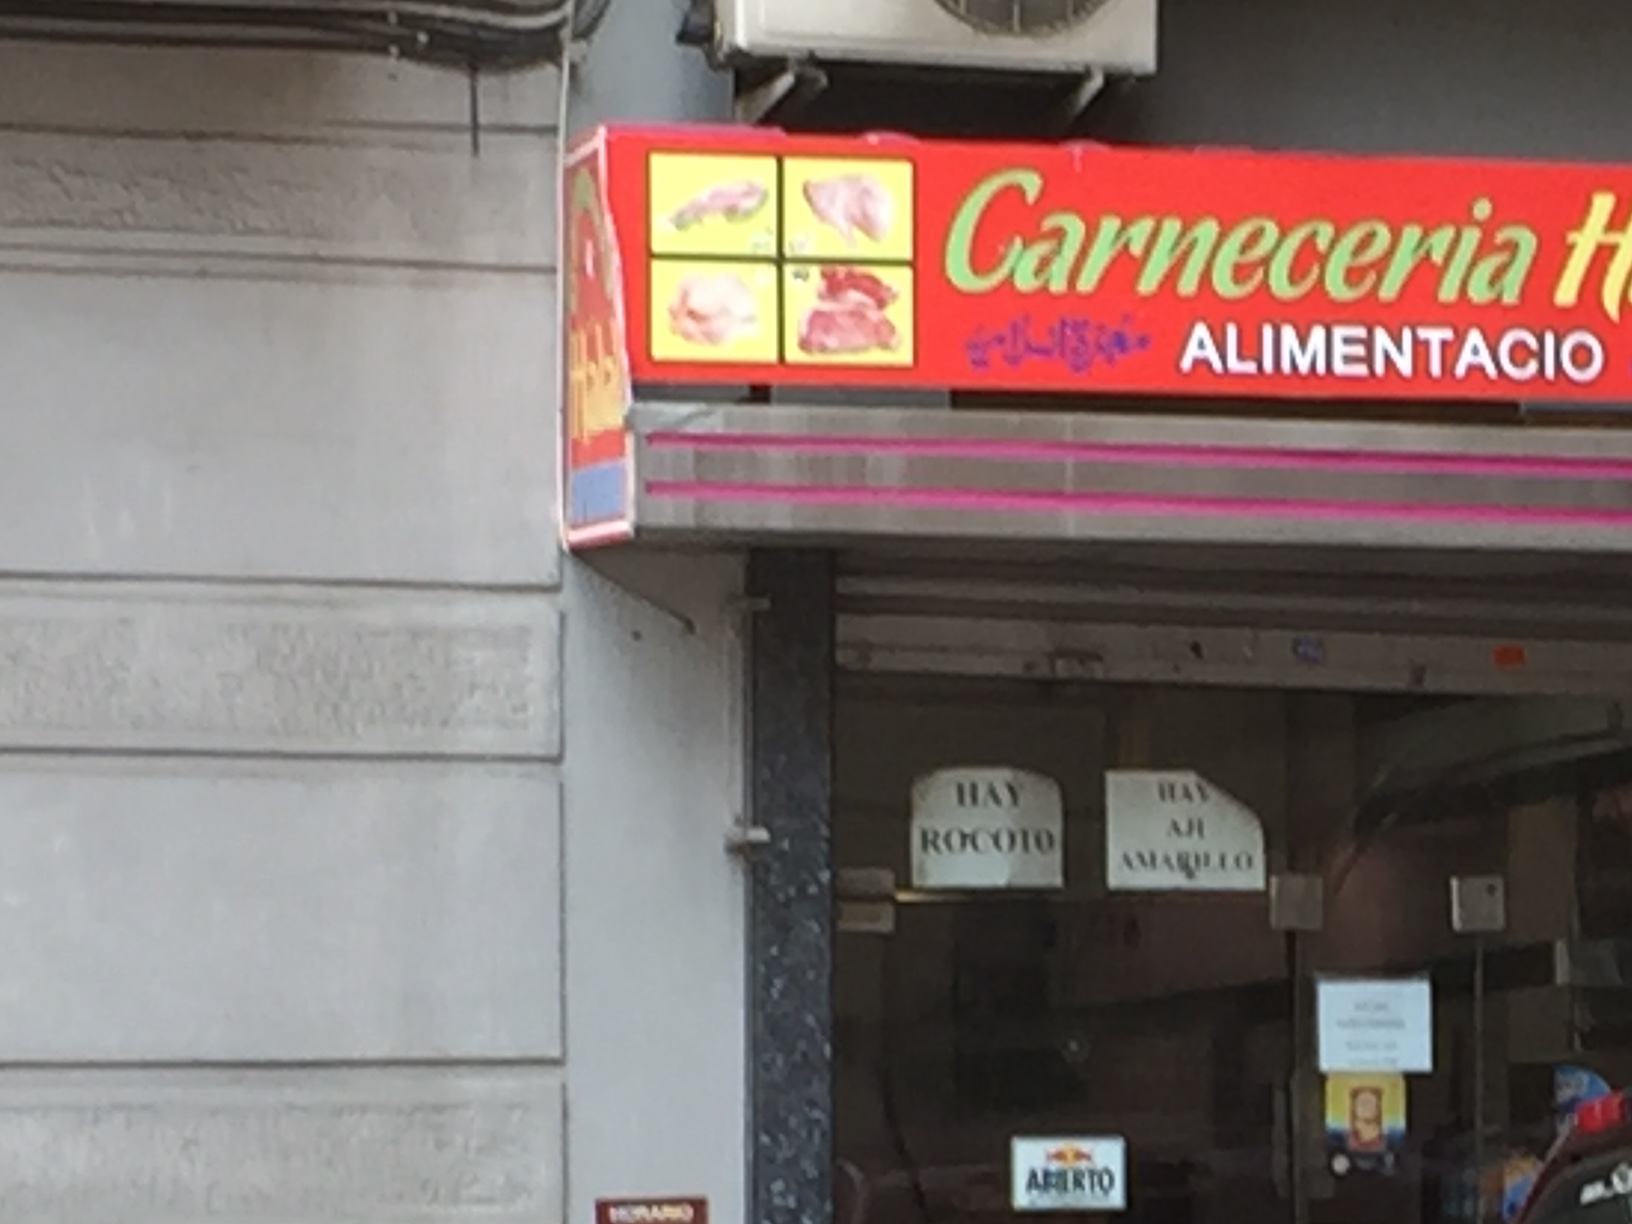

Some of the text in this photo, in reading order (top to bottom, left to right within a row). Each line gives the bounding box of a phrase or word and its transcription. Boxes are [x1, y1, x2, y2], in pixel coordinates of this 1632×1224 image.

[945, 169, 1538, 308] Carneceria
[1180, 321, 1604, 382] ALIMENTACIO
[956, 781, 1024, 810] HAY
[1156, 780, 1211, 804] HAY
[919, 828, 1056, 855] ROCOTO
[1165, 816, 1205, 840] AJI
[1119, 850, 1255, 875] AMARILLO
[1025, 1167, 1116, 1195] ABIERTO
